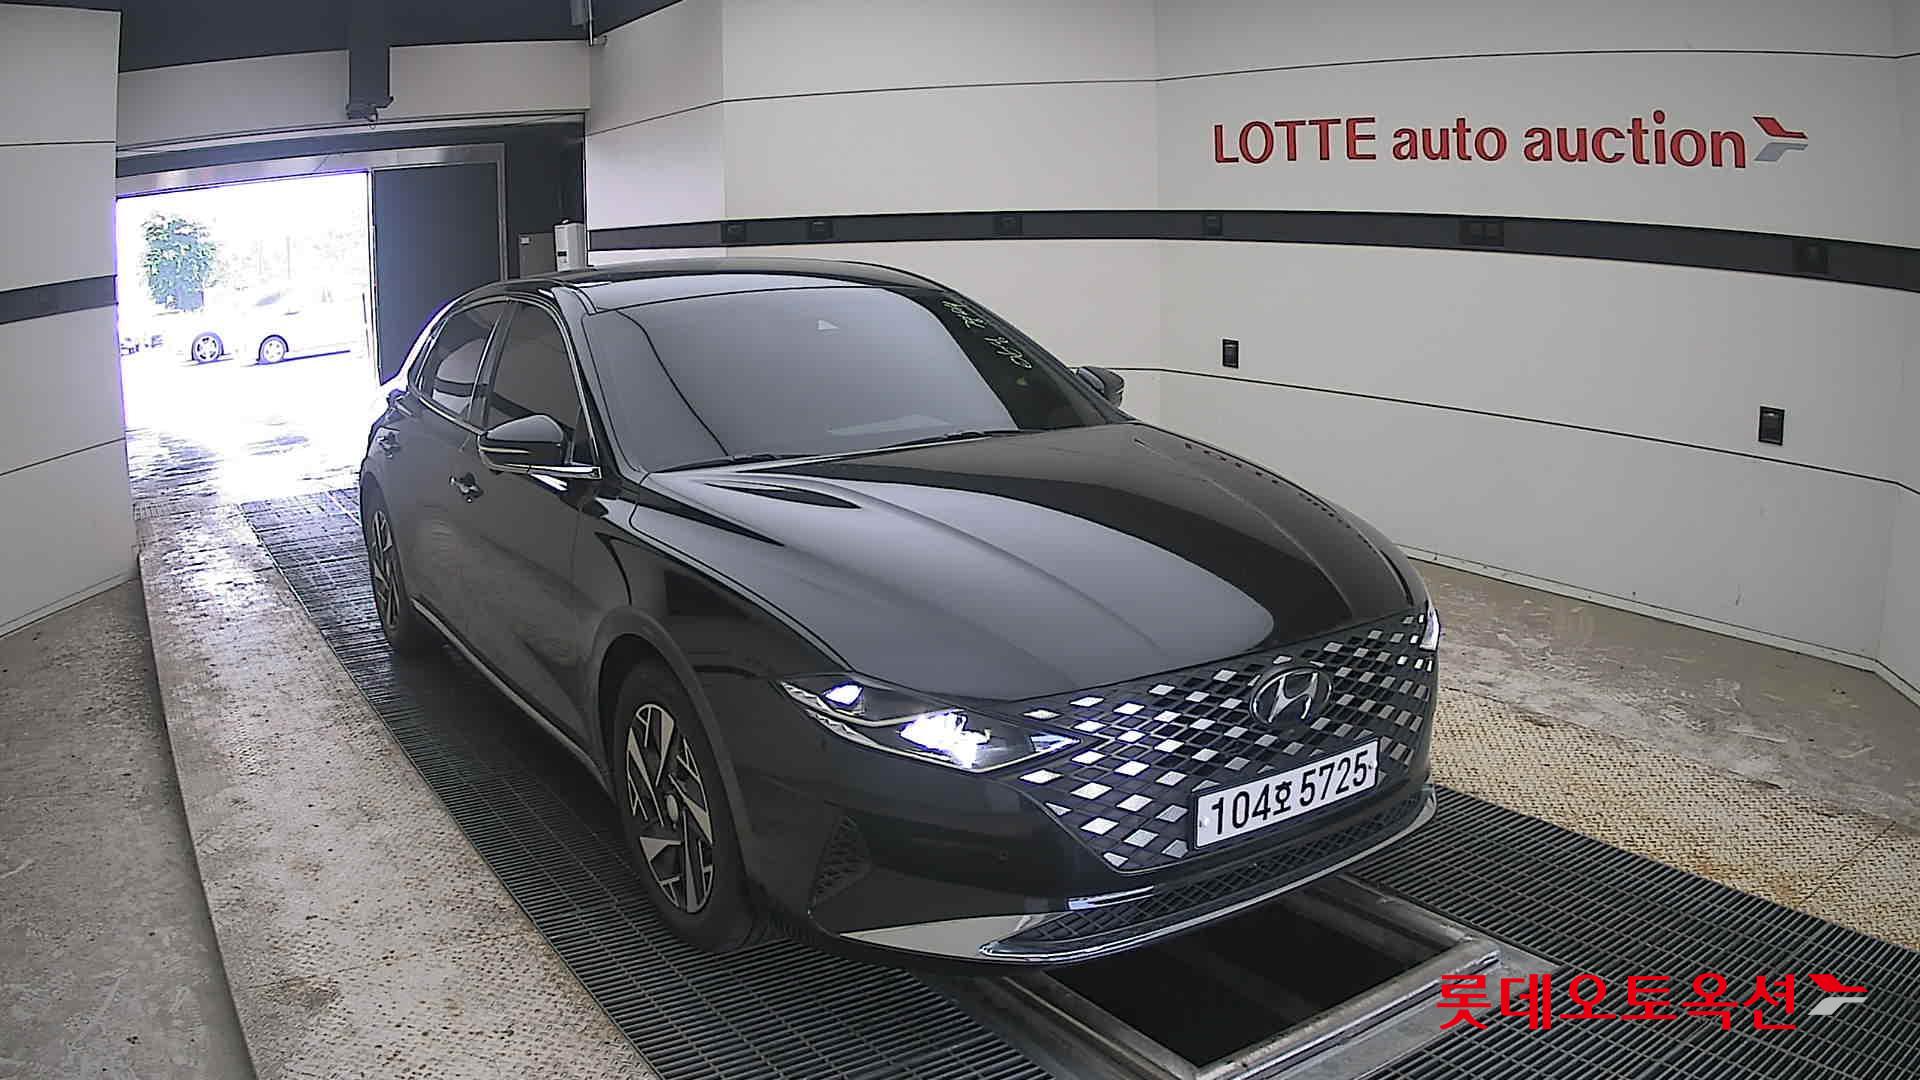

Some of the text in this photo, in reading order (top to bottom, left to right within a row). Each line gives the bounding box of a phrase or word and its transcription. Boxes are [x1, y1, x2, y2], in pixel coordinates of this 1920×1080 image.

[1213, 110, 1747, 169] LOTTE auto auction
[1299, 750, 1369, 808] 5725
